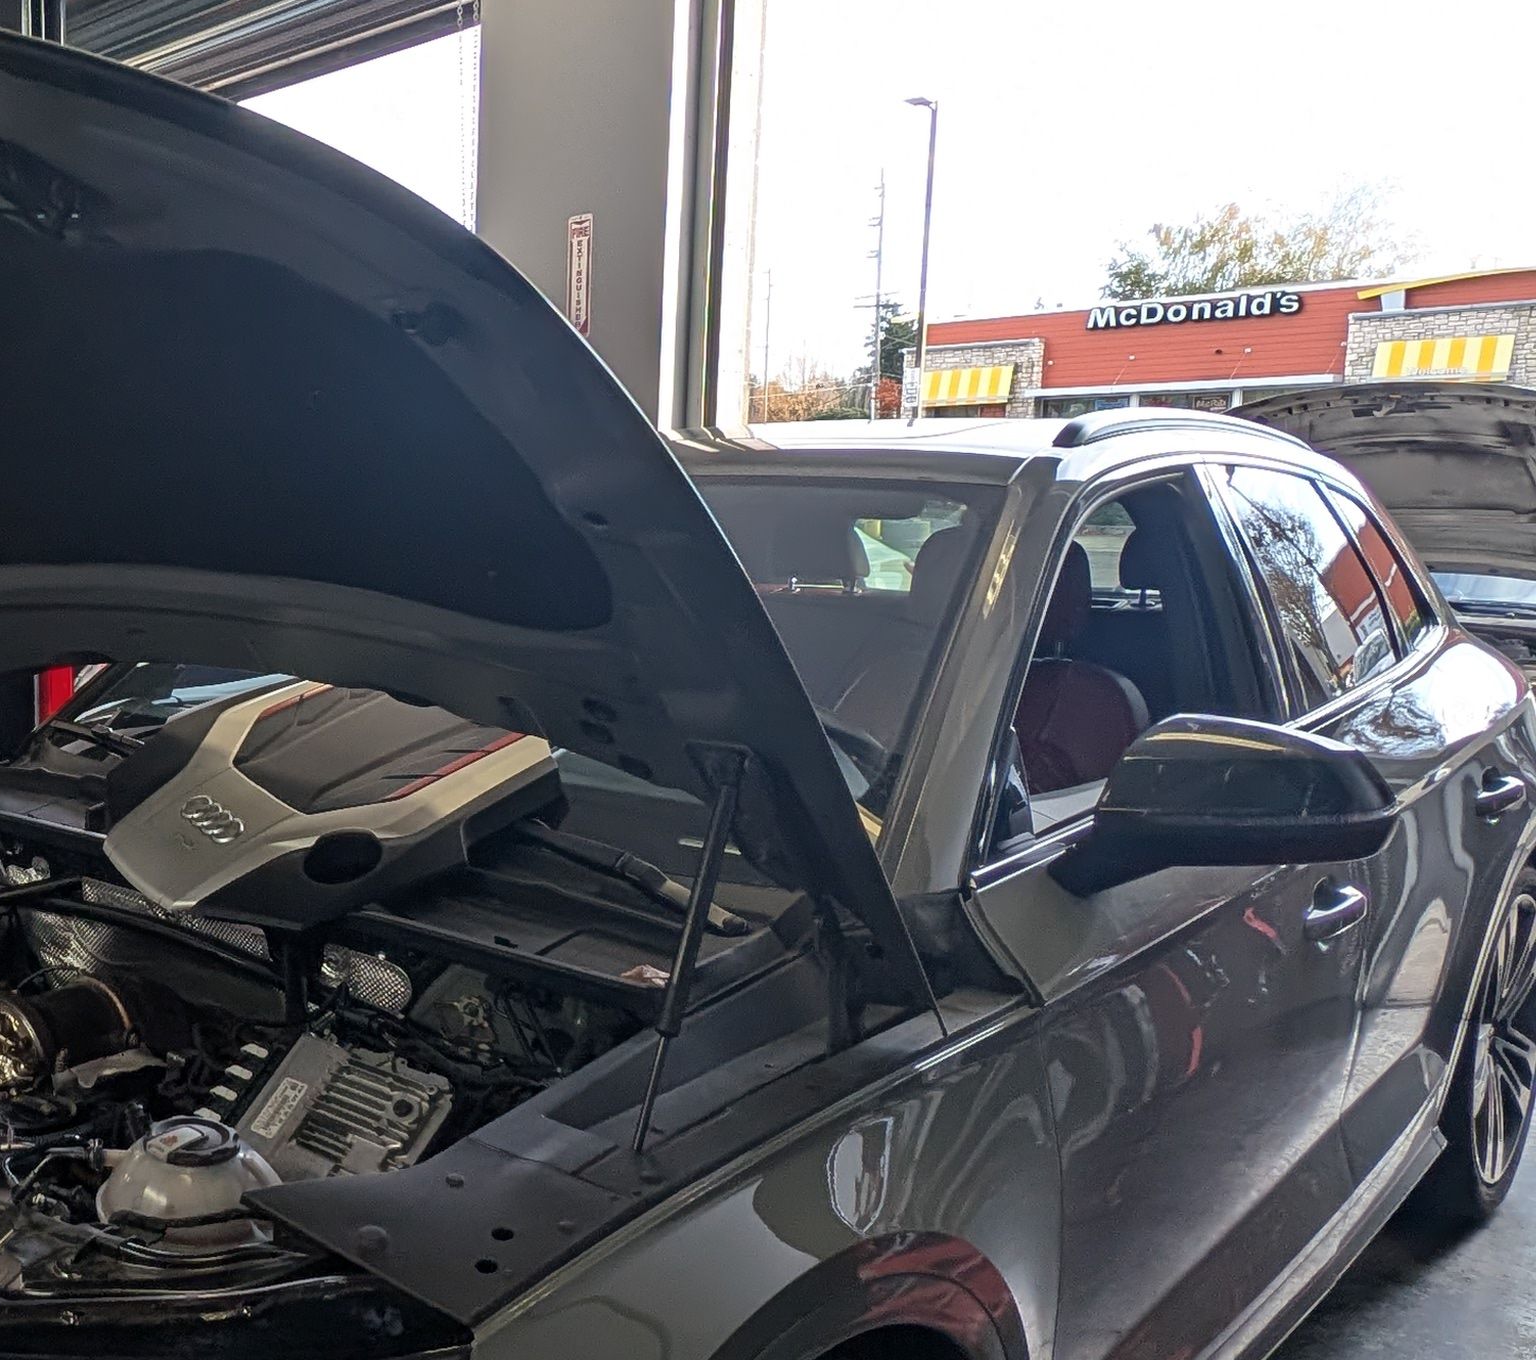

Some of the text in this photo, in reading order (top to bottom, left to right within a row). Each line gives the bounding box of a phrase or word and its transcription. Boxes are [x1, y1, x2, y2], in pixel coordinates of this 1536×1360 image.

[573, 226, 590, 239] FIRE
[575, 240, 583, 328] EXTINGUISHER
[1086, 292, 1302, 330] McDonald's
